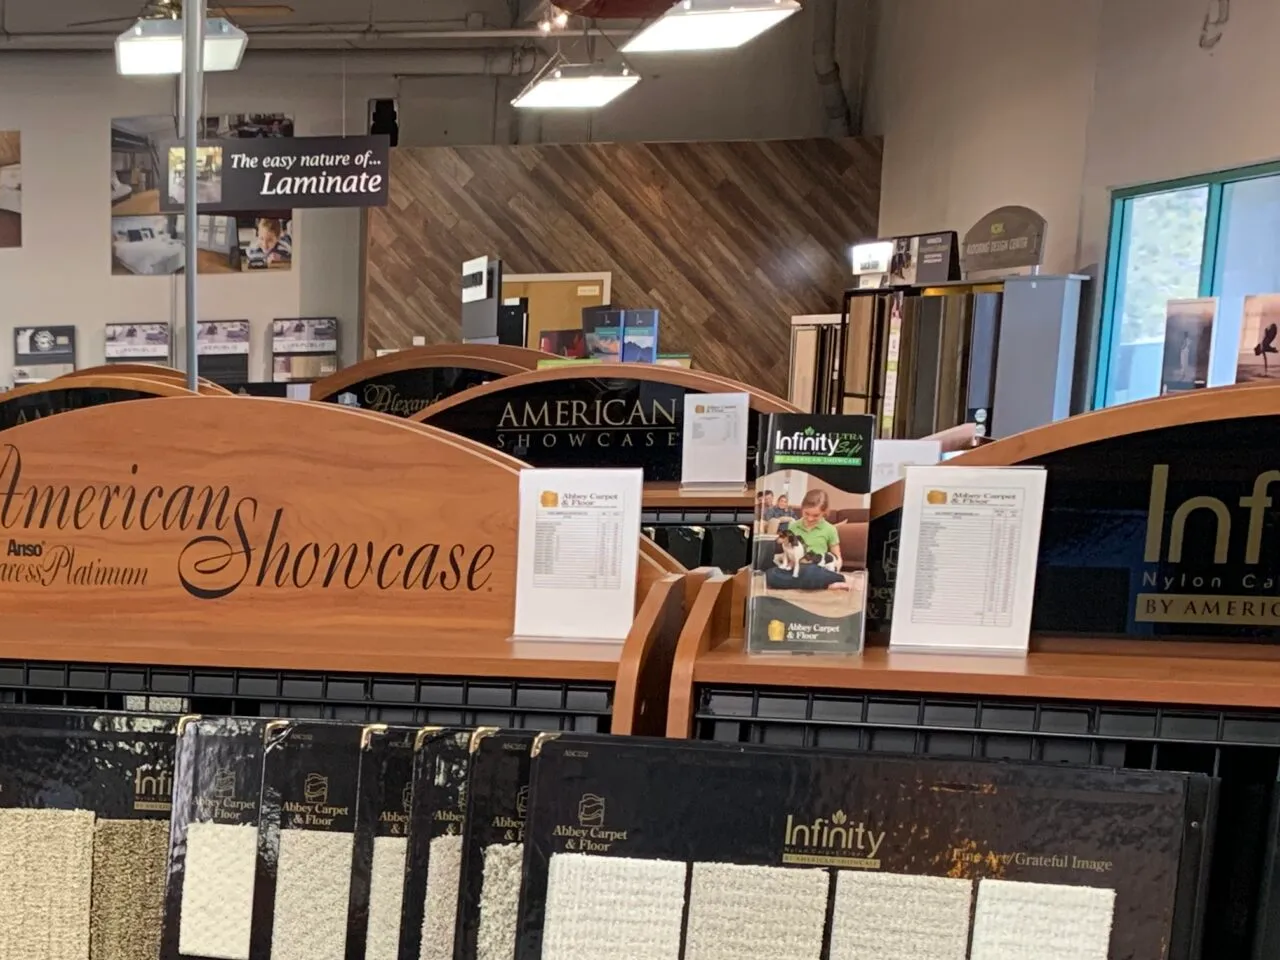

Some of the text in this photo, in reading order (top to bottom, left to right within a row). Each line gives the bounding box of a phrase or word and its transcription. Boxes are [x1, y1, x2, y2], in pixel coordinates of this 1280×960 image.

[231, 153, 258, 169] The
[262, 156, 296, 170] easy
[300, 153, 350, 167] nature
[260, 171, 382, 195] Laminate
[497, 398, 678, 427] AMERICAN
[496, 432, 678, 448] SHOWCASE
[776, 430, 840, 456] Infinity
[177, 496, 495, 600] Showcase
[41, 544, 149, 586] Platinum
[1142, 572, 1221, 590] Nylon
[1146, 599, 1173, 614] BY
[787, 631, 819, 640] & Floor
[788, 623, 840, 634] Abbey Carpet
[135, 767, 172, 796] Infi
[223, 797, 256, 810] Carpet
[282, 801, 349, 816] Abbey Carpet
[214, 808, 241, 819] Floor
[293, 814, 334, 826] & Floor
[390, 823, 401, 834] &
[446, 823, 456, 834] &
[504, 829, 515, 840] &
[552, 825, 628, 841] Abbey Carpet
[784, 814, 886, 858] Infinity
[565, 838, 612, 852] & Floor
[1072, 855, 1114, 873] Image
